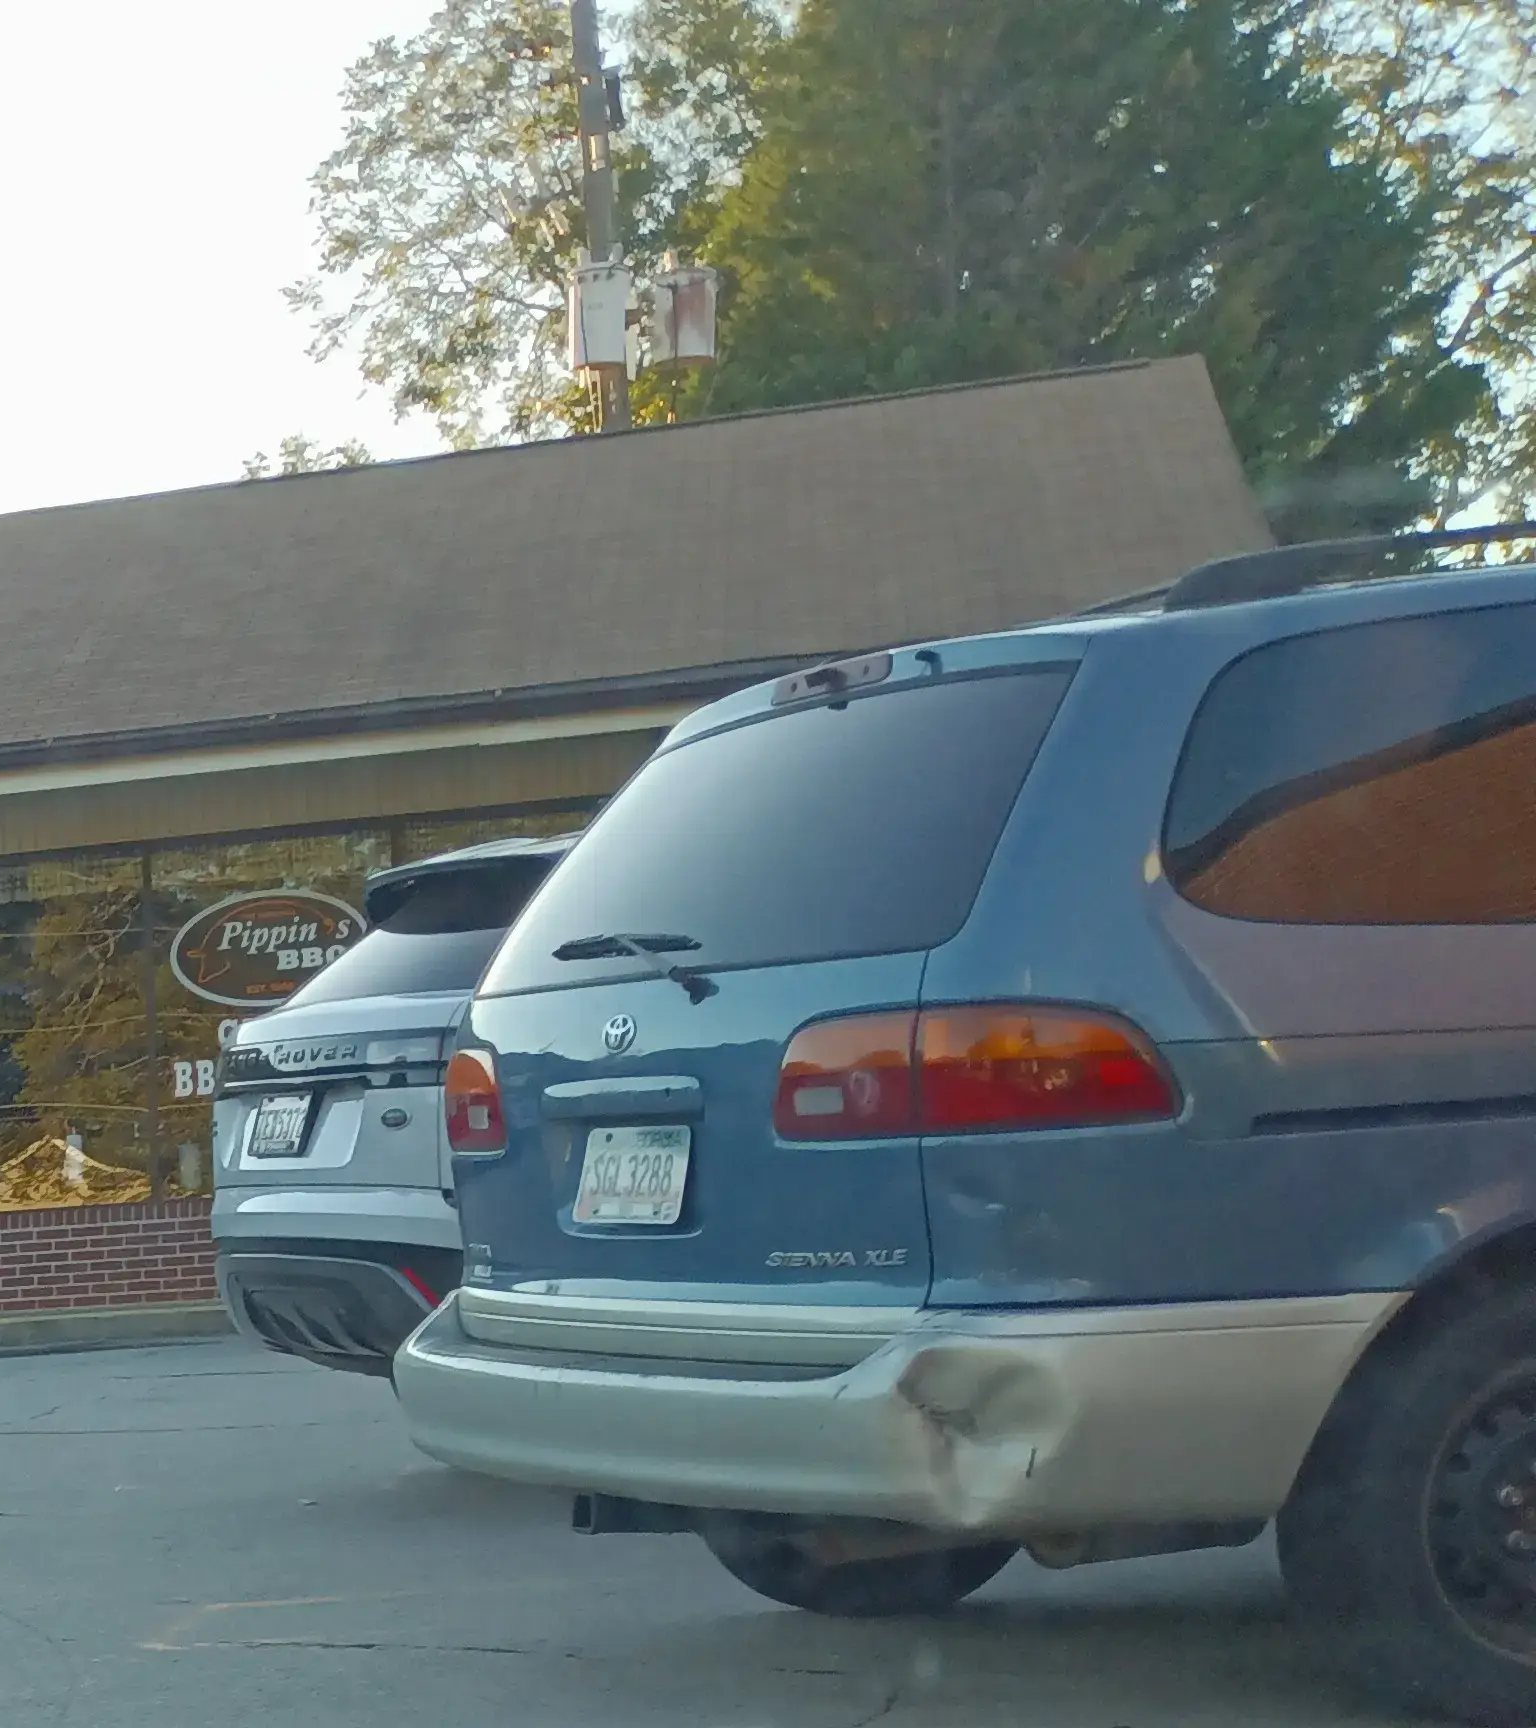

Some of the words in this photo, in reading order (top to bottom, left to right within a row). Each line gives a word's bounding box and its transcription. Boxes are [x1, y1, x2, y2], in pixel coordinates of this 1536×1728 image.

[173, 1060, 216, 1098] BB
[765, 1251, 856, 1267] SIENNA
[864, 1248, 908, 1266] XLE
